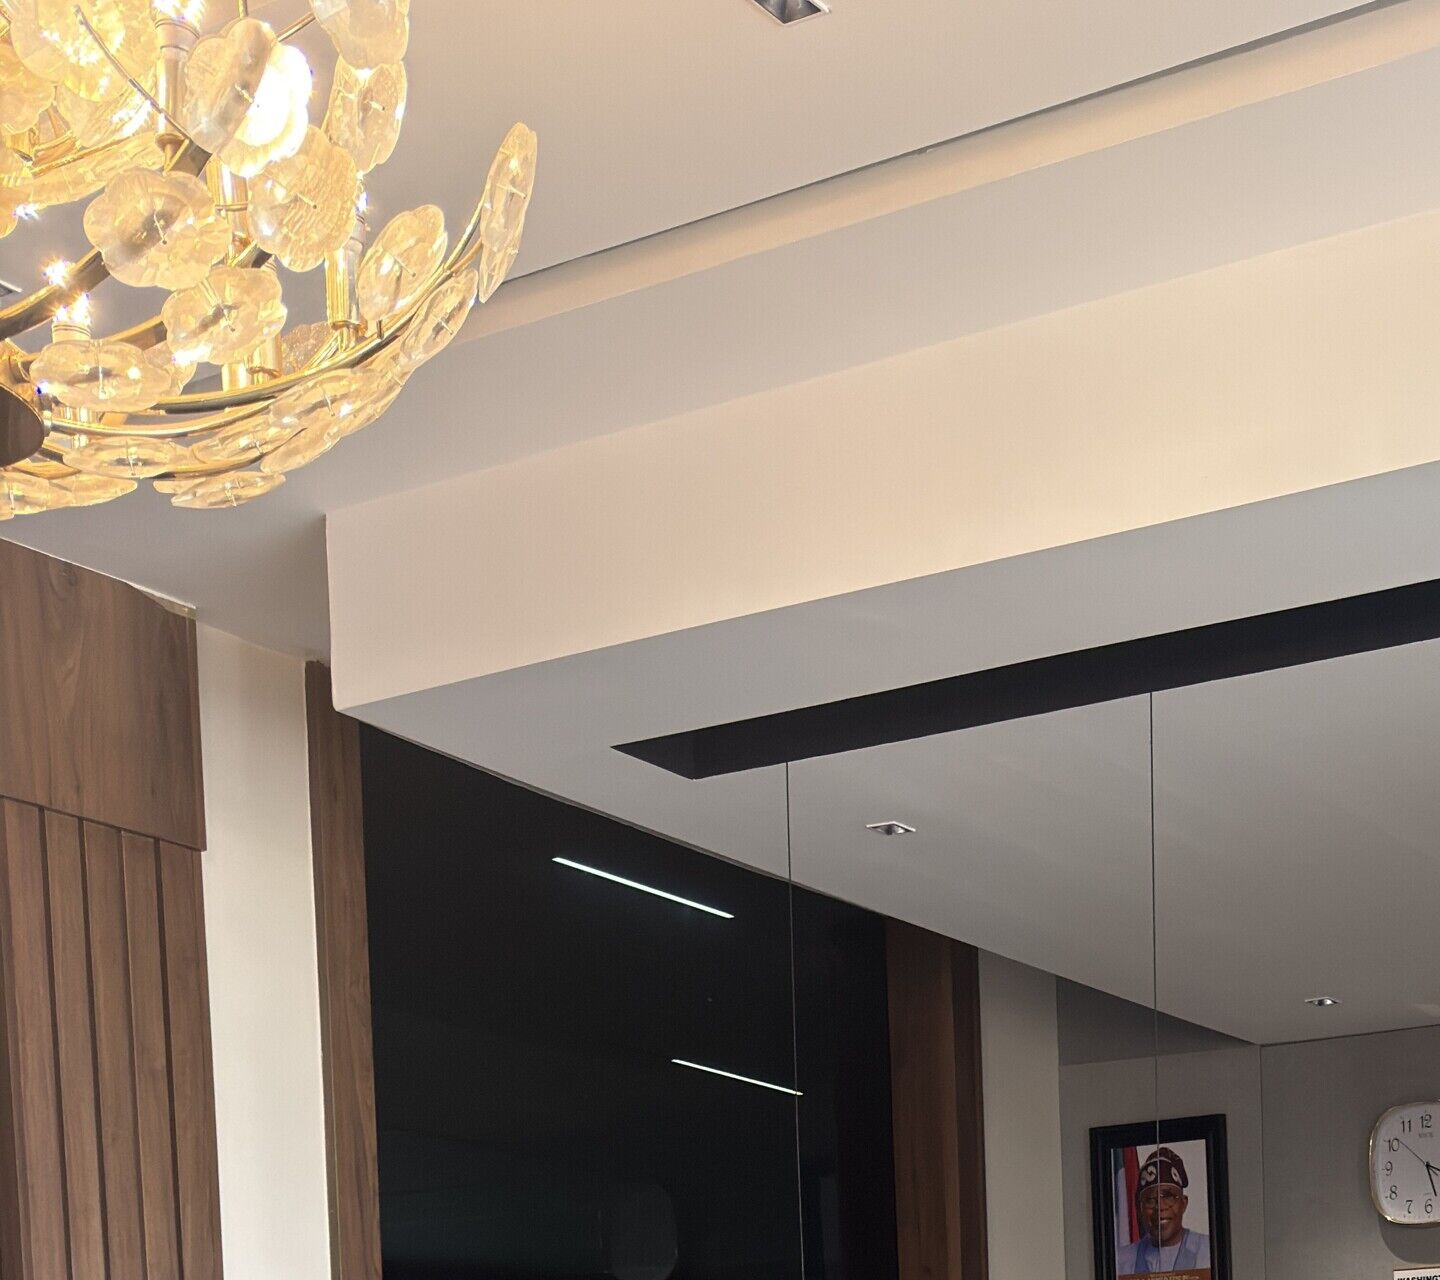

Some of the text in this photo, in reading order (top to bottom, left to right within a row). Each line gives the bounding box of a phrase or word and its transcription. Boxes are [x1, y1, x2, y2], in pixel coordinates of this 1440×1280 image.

[1400, 1120, 1412, 1133] 11
[1420, 1113, 1432, 1128] 12
[1387, 1138, 1400, 1152] 10
[1385, 1161, 1393, 1176] 9
[1389, 1185, 1398, 1200] 8
[1405, 1200, 1413, 1214] 7
[1424, 1198, 1433, 1214] 6
